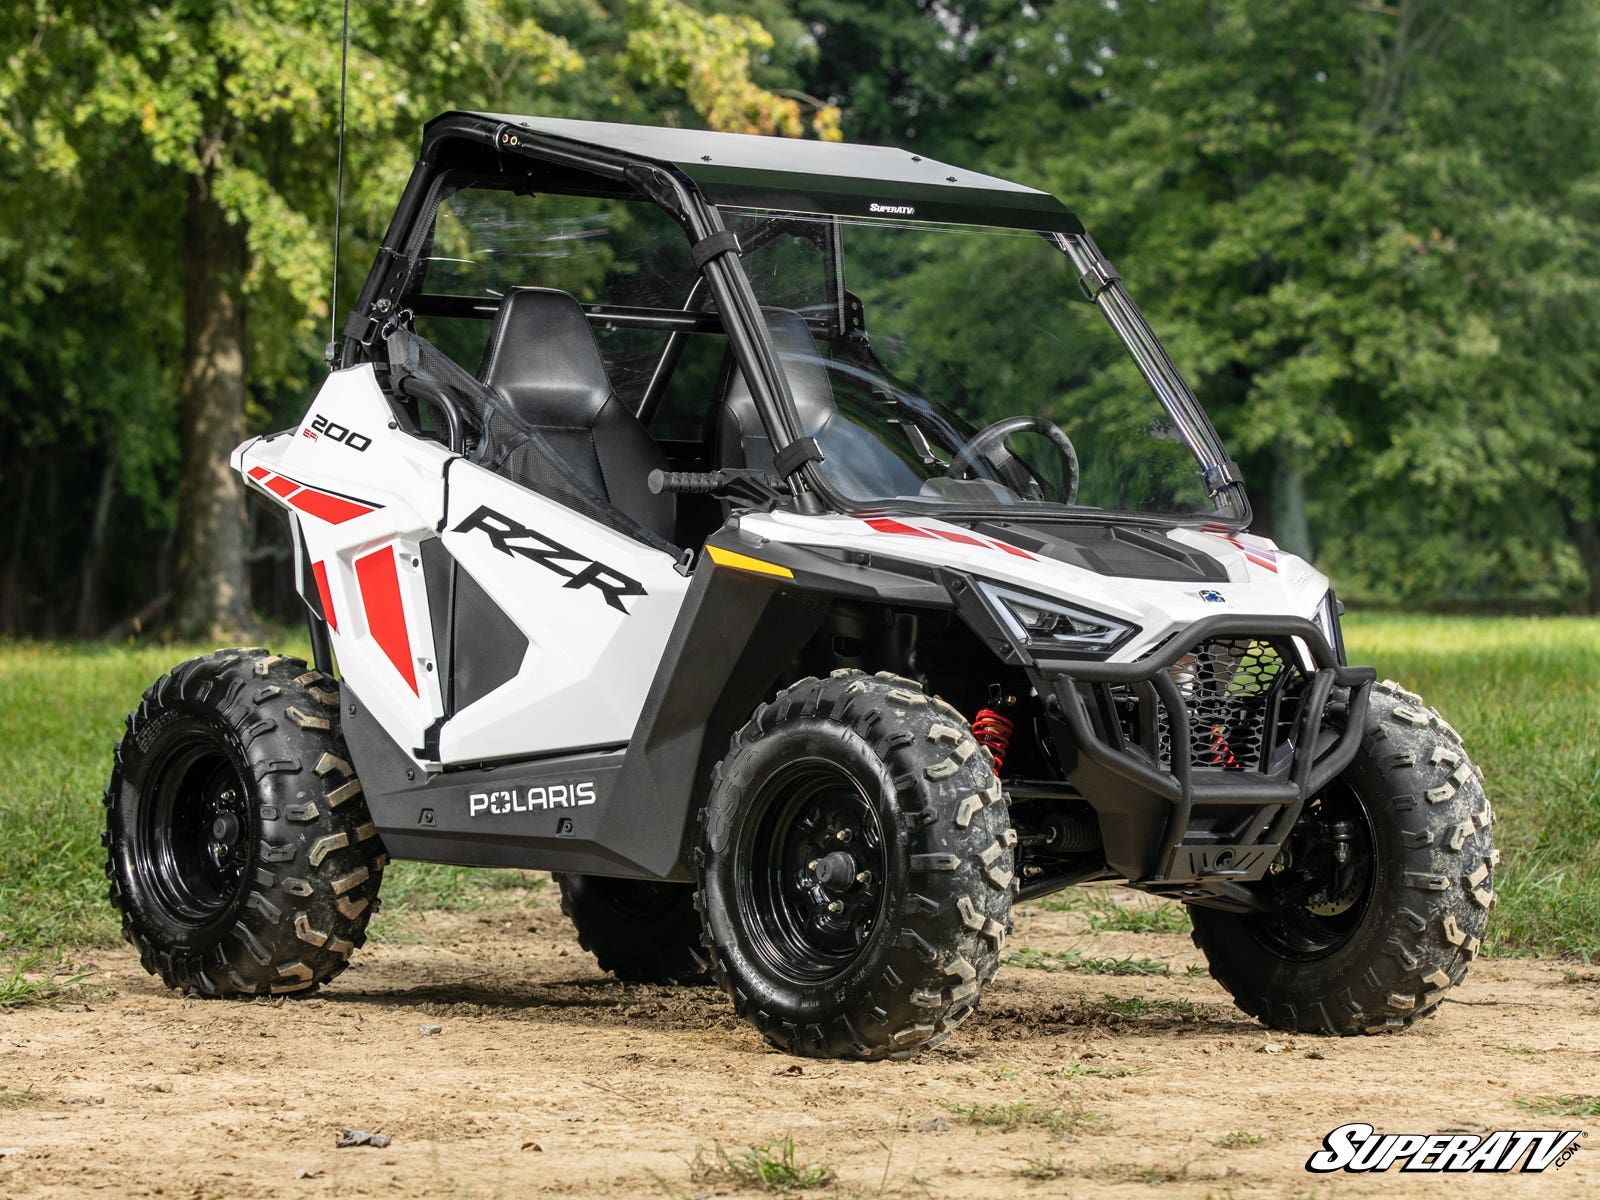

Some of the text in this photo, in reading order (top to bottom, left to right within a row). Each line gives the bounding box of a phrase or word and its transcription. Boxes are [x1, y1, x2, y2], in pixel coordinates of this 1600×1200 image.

[869, 203, 915, 214] SUPERATV
[311, 413, 372, 452] 200
[450, 504, 649, 616] RZR
[469, 782, 596, 817] POLARIS
